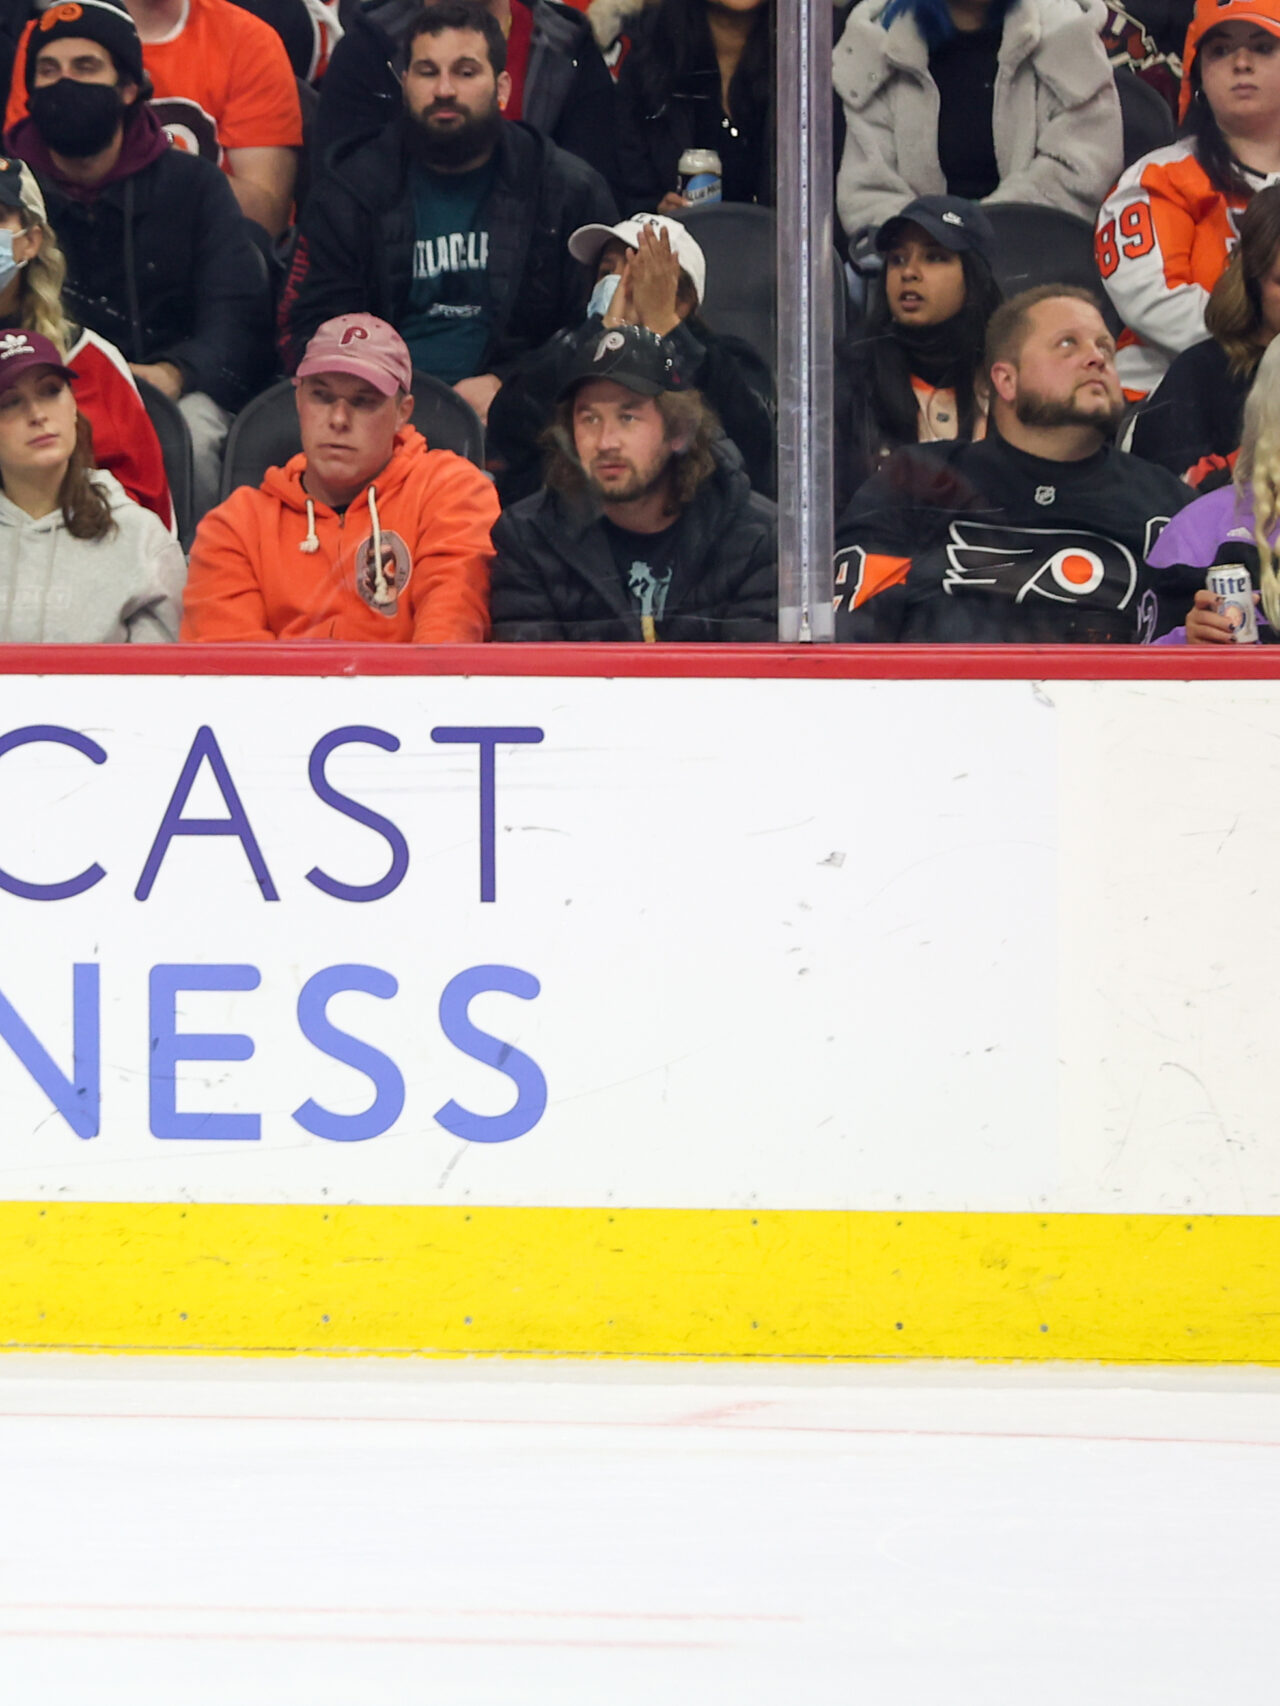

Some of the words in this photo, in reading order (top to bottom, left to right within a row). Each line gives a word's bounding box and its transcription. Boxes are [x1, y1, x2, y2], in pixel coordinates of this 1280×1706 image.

[1095, 200, 1155, 280] 89
[338, 325, 369, 347] P
[592, 331, 626, 363] P
[1211, 577, 1246, 596] lite
